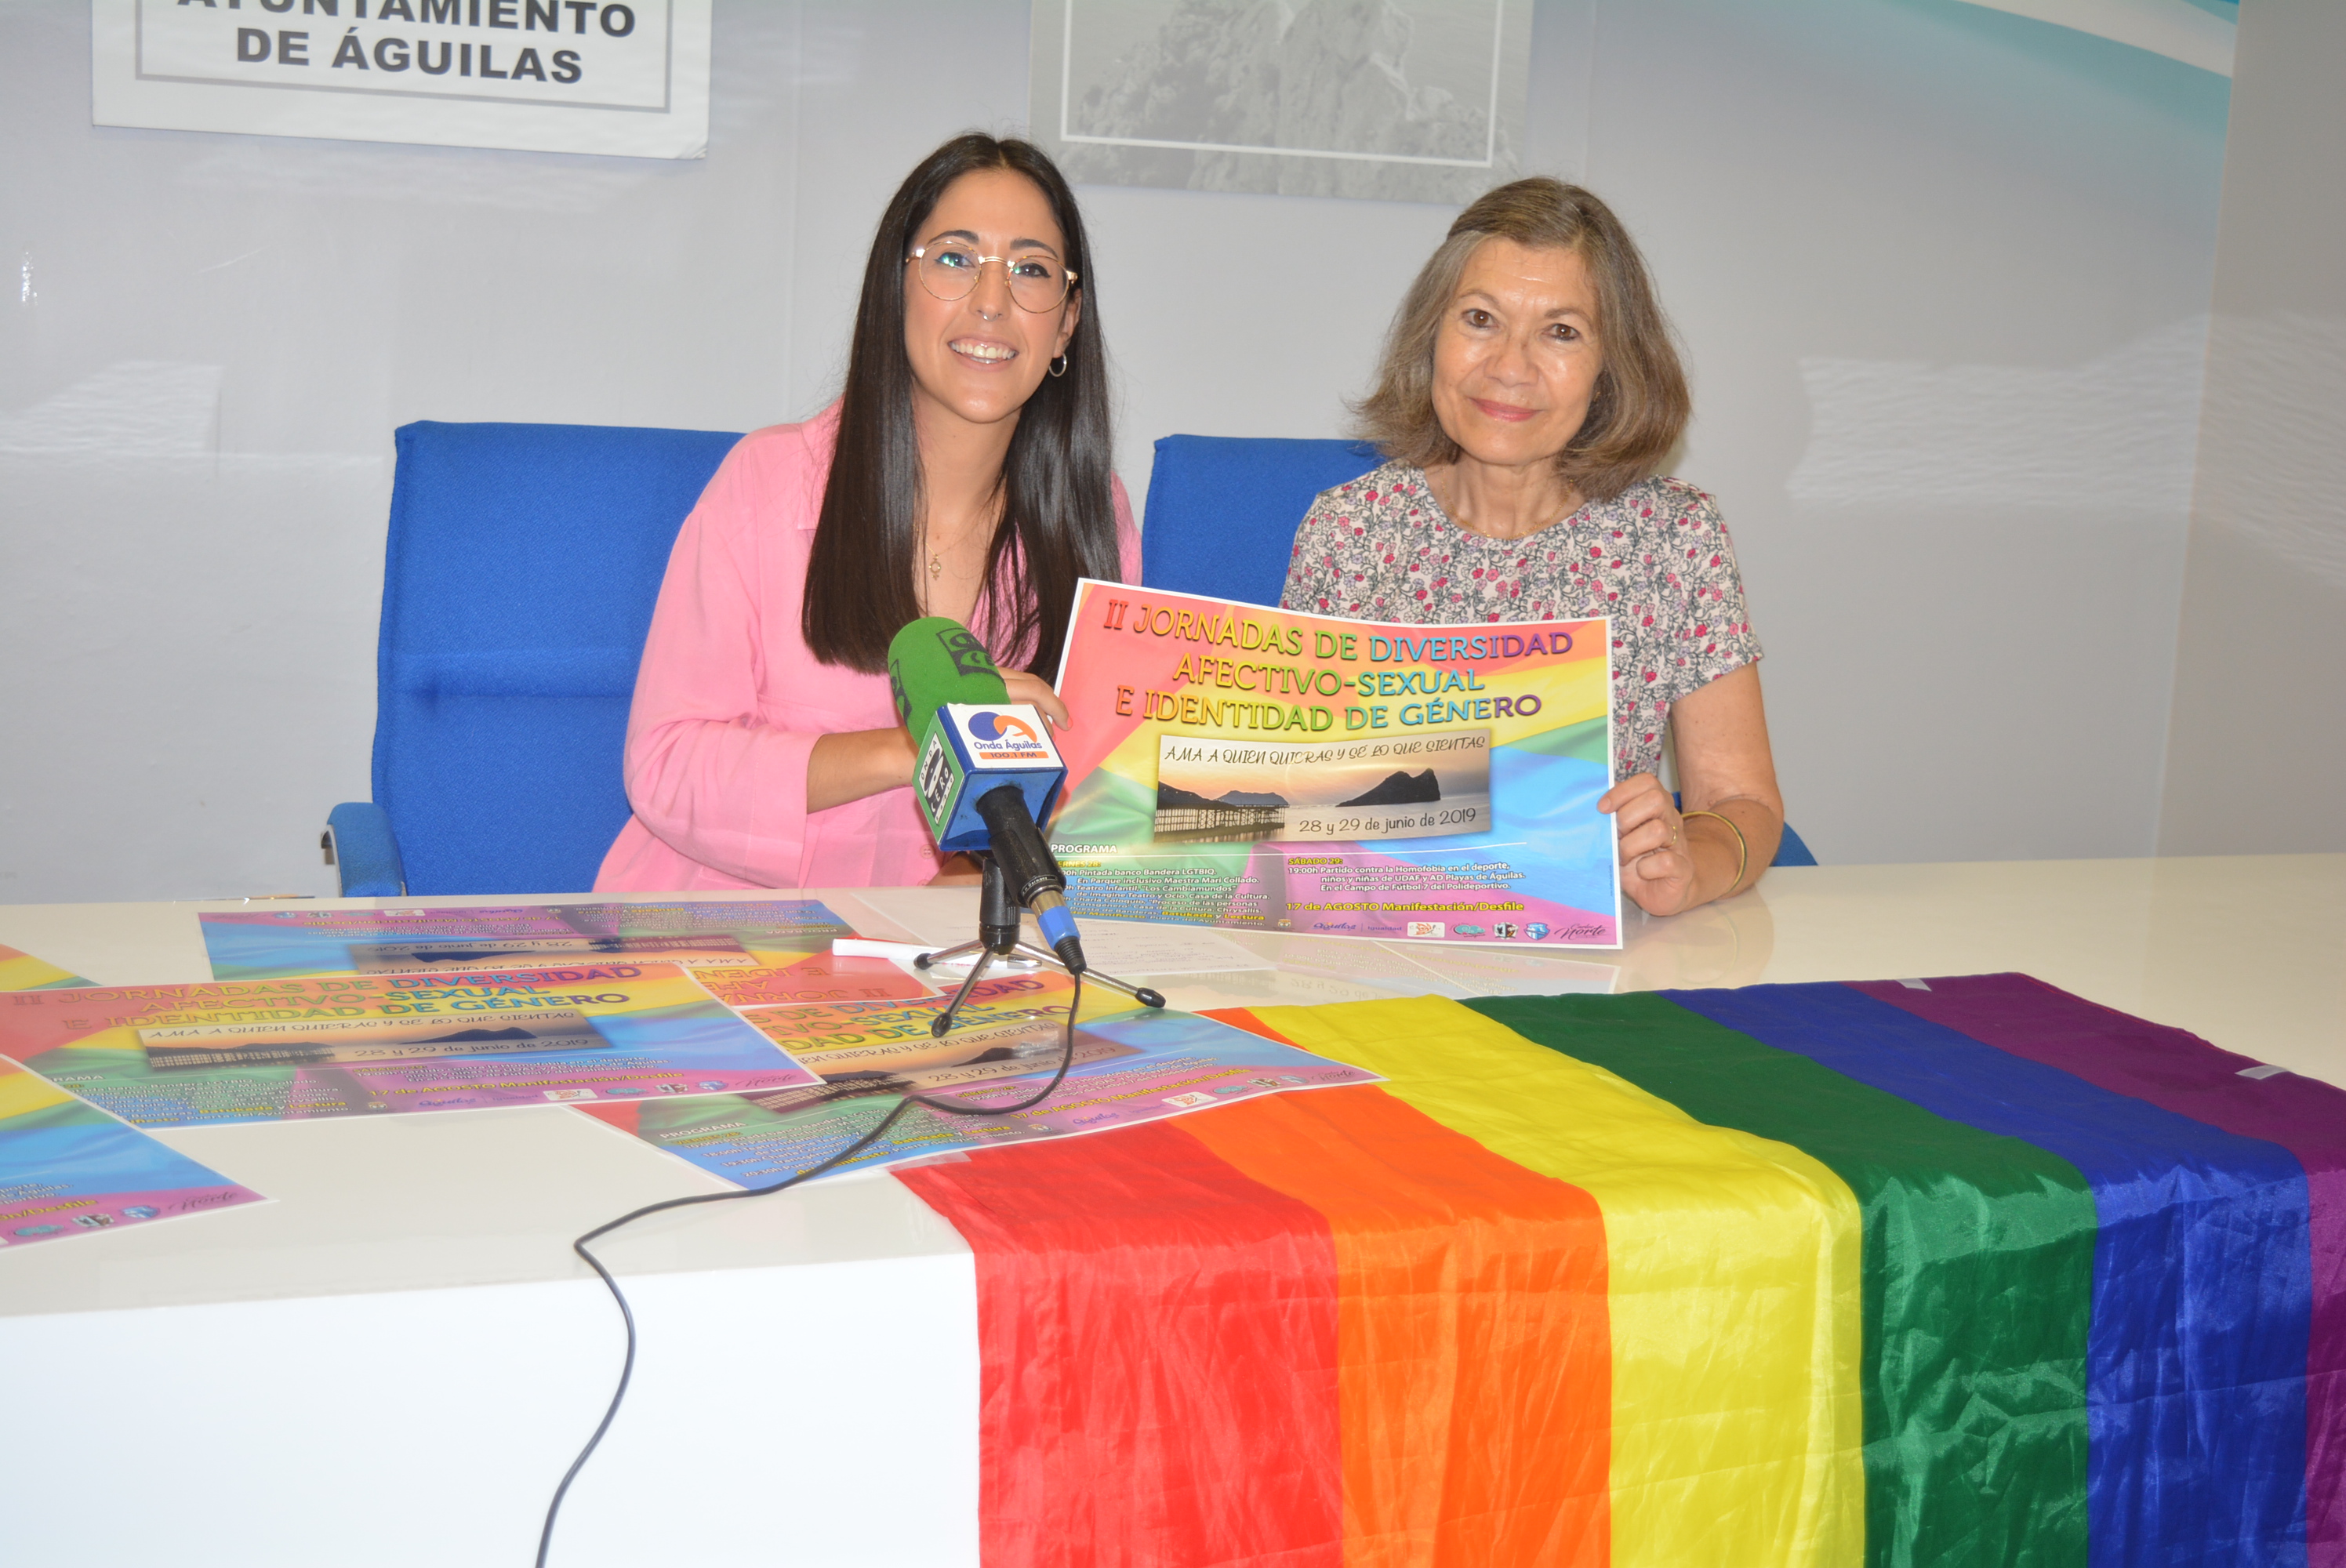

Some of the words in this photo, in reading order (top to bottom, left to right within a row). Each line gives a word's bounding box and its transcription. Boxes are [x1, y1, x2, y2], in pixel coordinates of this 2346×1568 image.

[238, 27, 310, 66] DE
[332, 27, 583, 84] ÁGUILAS
[1104, 599, 1128, 629] II
[1134, 604, 1302, 655] JORNADAS
[1315, 630, 1357, 659] DE
[1369, 632, 1573, 662] DIVERSIDAD
[1173, 652, 1485, 696] AFECTIVO-SEXUAL
[1116, 684, 1135, 716] E
[1143, 688, 1333, 731] IDENTIDAD
[1346, 706, 1388, 730] DE
[1400, 695, 1542, 725] GÉNERO
[974, 740, 1003, 750] Onda
[1005, 739, 1043, 751] Águilas
[1164, 746, 1202, 761] AMA
[1208, 749, 1218, 763] A
[1223, 749, 1266, 765] QUIEN
[1393, 741, 1422, 756] QUE
[1426, 735, 1485, 753] SIENTAS
[1299, 820, 1322, 833] 28
[1327, 822, 1335, 836] y
[1339, 818, 1360, 832] 29
[1364, 817, 1380, 831] de
[1381, 815, 1415, 834] junio
[1419, 812, 1435, 826] de
[1440, 808, 1476, 826] 2019
[1051, 844, 1117, 854] PROGRAMA
[1288, 856, 1327, 865] SÁBADO
[1320, 866, 1353, 874] Partido
[1395, 864, 1446, 873] Homofobia
[1461, 863, 1469, 872] el
[1471, 861, 1510, 872] deporte,
[1223, 876, 1260, 884] Collado.
[1445, 873, 1474, 883] Playas
[1489, 870, 1526, 881] Águilas.
[1344, 884, 1377, 892] Campo
[1378, 883, 1390, 891] de
[1391, 882, 1421, 891] Fútbol
[1430, 882, 1445, 891] del
[1447, 881, 1511, 891] Polideportivo.
[1161, 910, 1213, 919] Batukada
[1286, 902, 1302, 911] 17
[1304, 902, 1321, 911] de
[1323, 902, 1380, 912] AGOSTO
[1382, 901, 1524, 912] Manifestación/Desfile
[59, 983, 305, 1004] JORNADAS
[318, 980, 378, 992] DE
[388, 966, 642, 989] DIVERSIDAD
[140, 985, 550, 1013] AFECTIVO-SEXUAL
[64, 1019, 92, 1029] E
[105, 1006, 365, 1028] IDENTIDAD
[378, 1002, 440, 1014] DE
[451, 993, 630, 1011] GÉNERO
[772, 1007, 833, 1020] DE
[866, 1024, 928, 1040] DE
[421, 1083, 496, 1094] AGOSTO
[1031, 1108, 1051, 1116] de
[1052, 1097, 1110, 1112] AGOSTO
[659, 1122, 747, 1139] PROGRAMA
